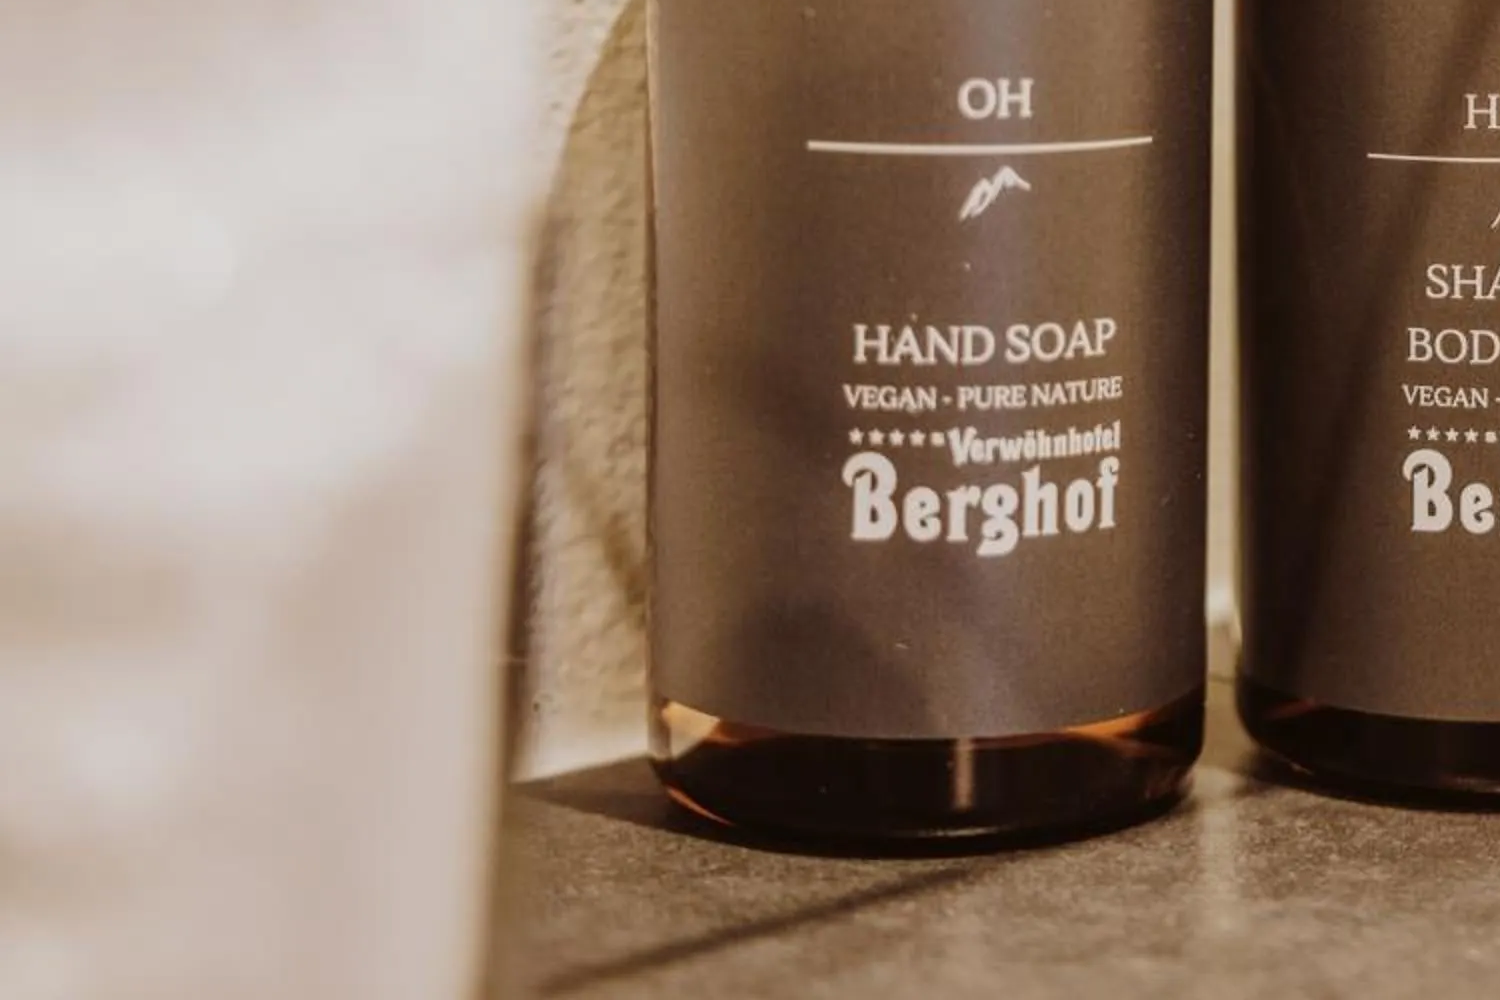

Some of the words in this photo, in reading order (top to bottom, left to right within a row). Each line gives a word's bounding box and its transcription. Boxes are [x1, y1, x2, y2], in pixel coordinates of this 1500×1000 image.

[957, 77, 1034, 120] OH
[853, 323, 996, 366] HAND
[1004, 317, 1117, 364] SOAP
[842, 384, 938, 412] VEGAN
[957, 384, 1028, 410] PURE
[1030, 375, 1123, 407] NATURE
[1401, 384, 1489, 409] VEGAN
[842, 452, 1120, 557] Berghof
